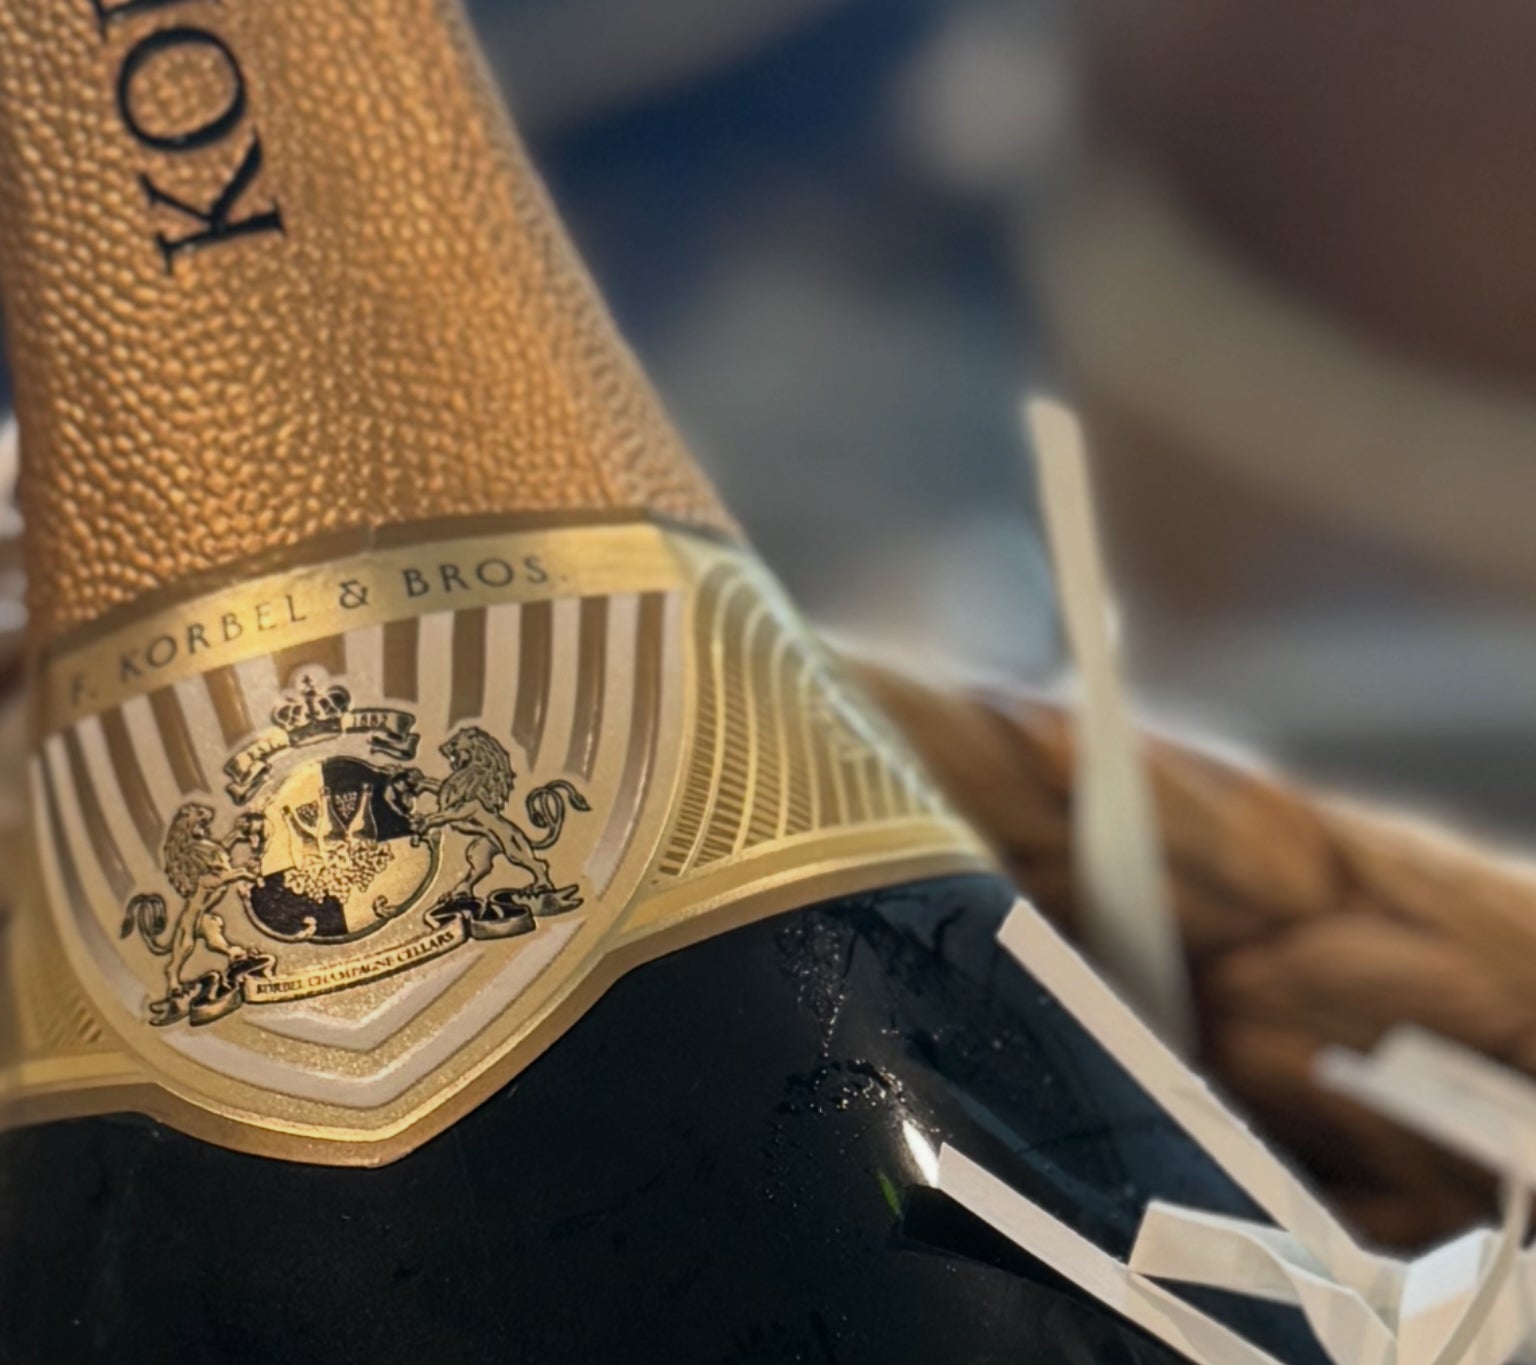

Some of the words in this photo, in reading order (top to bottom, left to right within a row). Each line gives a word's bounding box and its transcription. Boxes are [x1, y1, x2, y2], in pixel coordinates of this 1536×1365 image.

[117, 593, 308, 684] KORBEL
[338, 578, 370, 611] &
[255, 976, 303, 995] KORBEL
[307, 956, 393, 987] CHAMPAGNE
[396, 929, 455, 964] CELLARS
